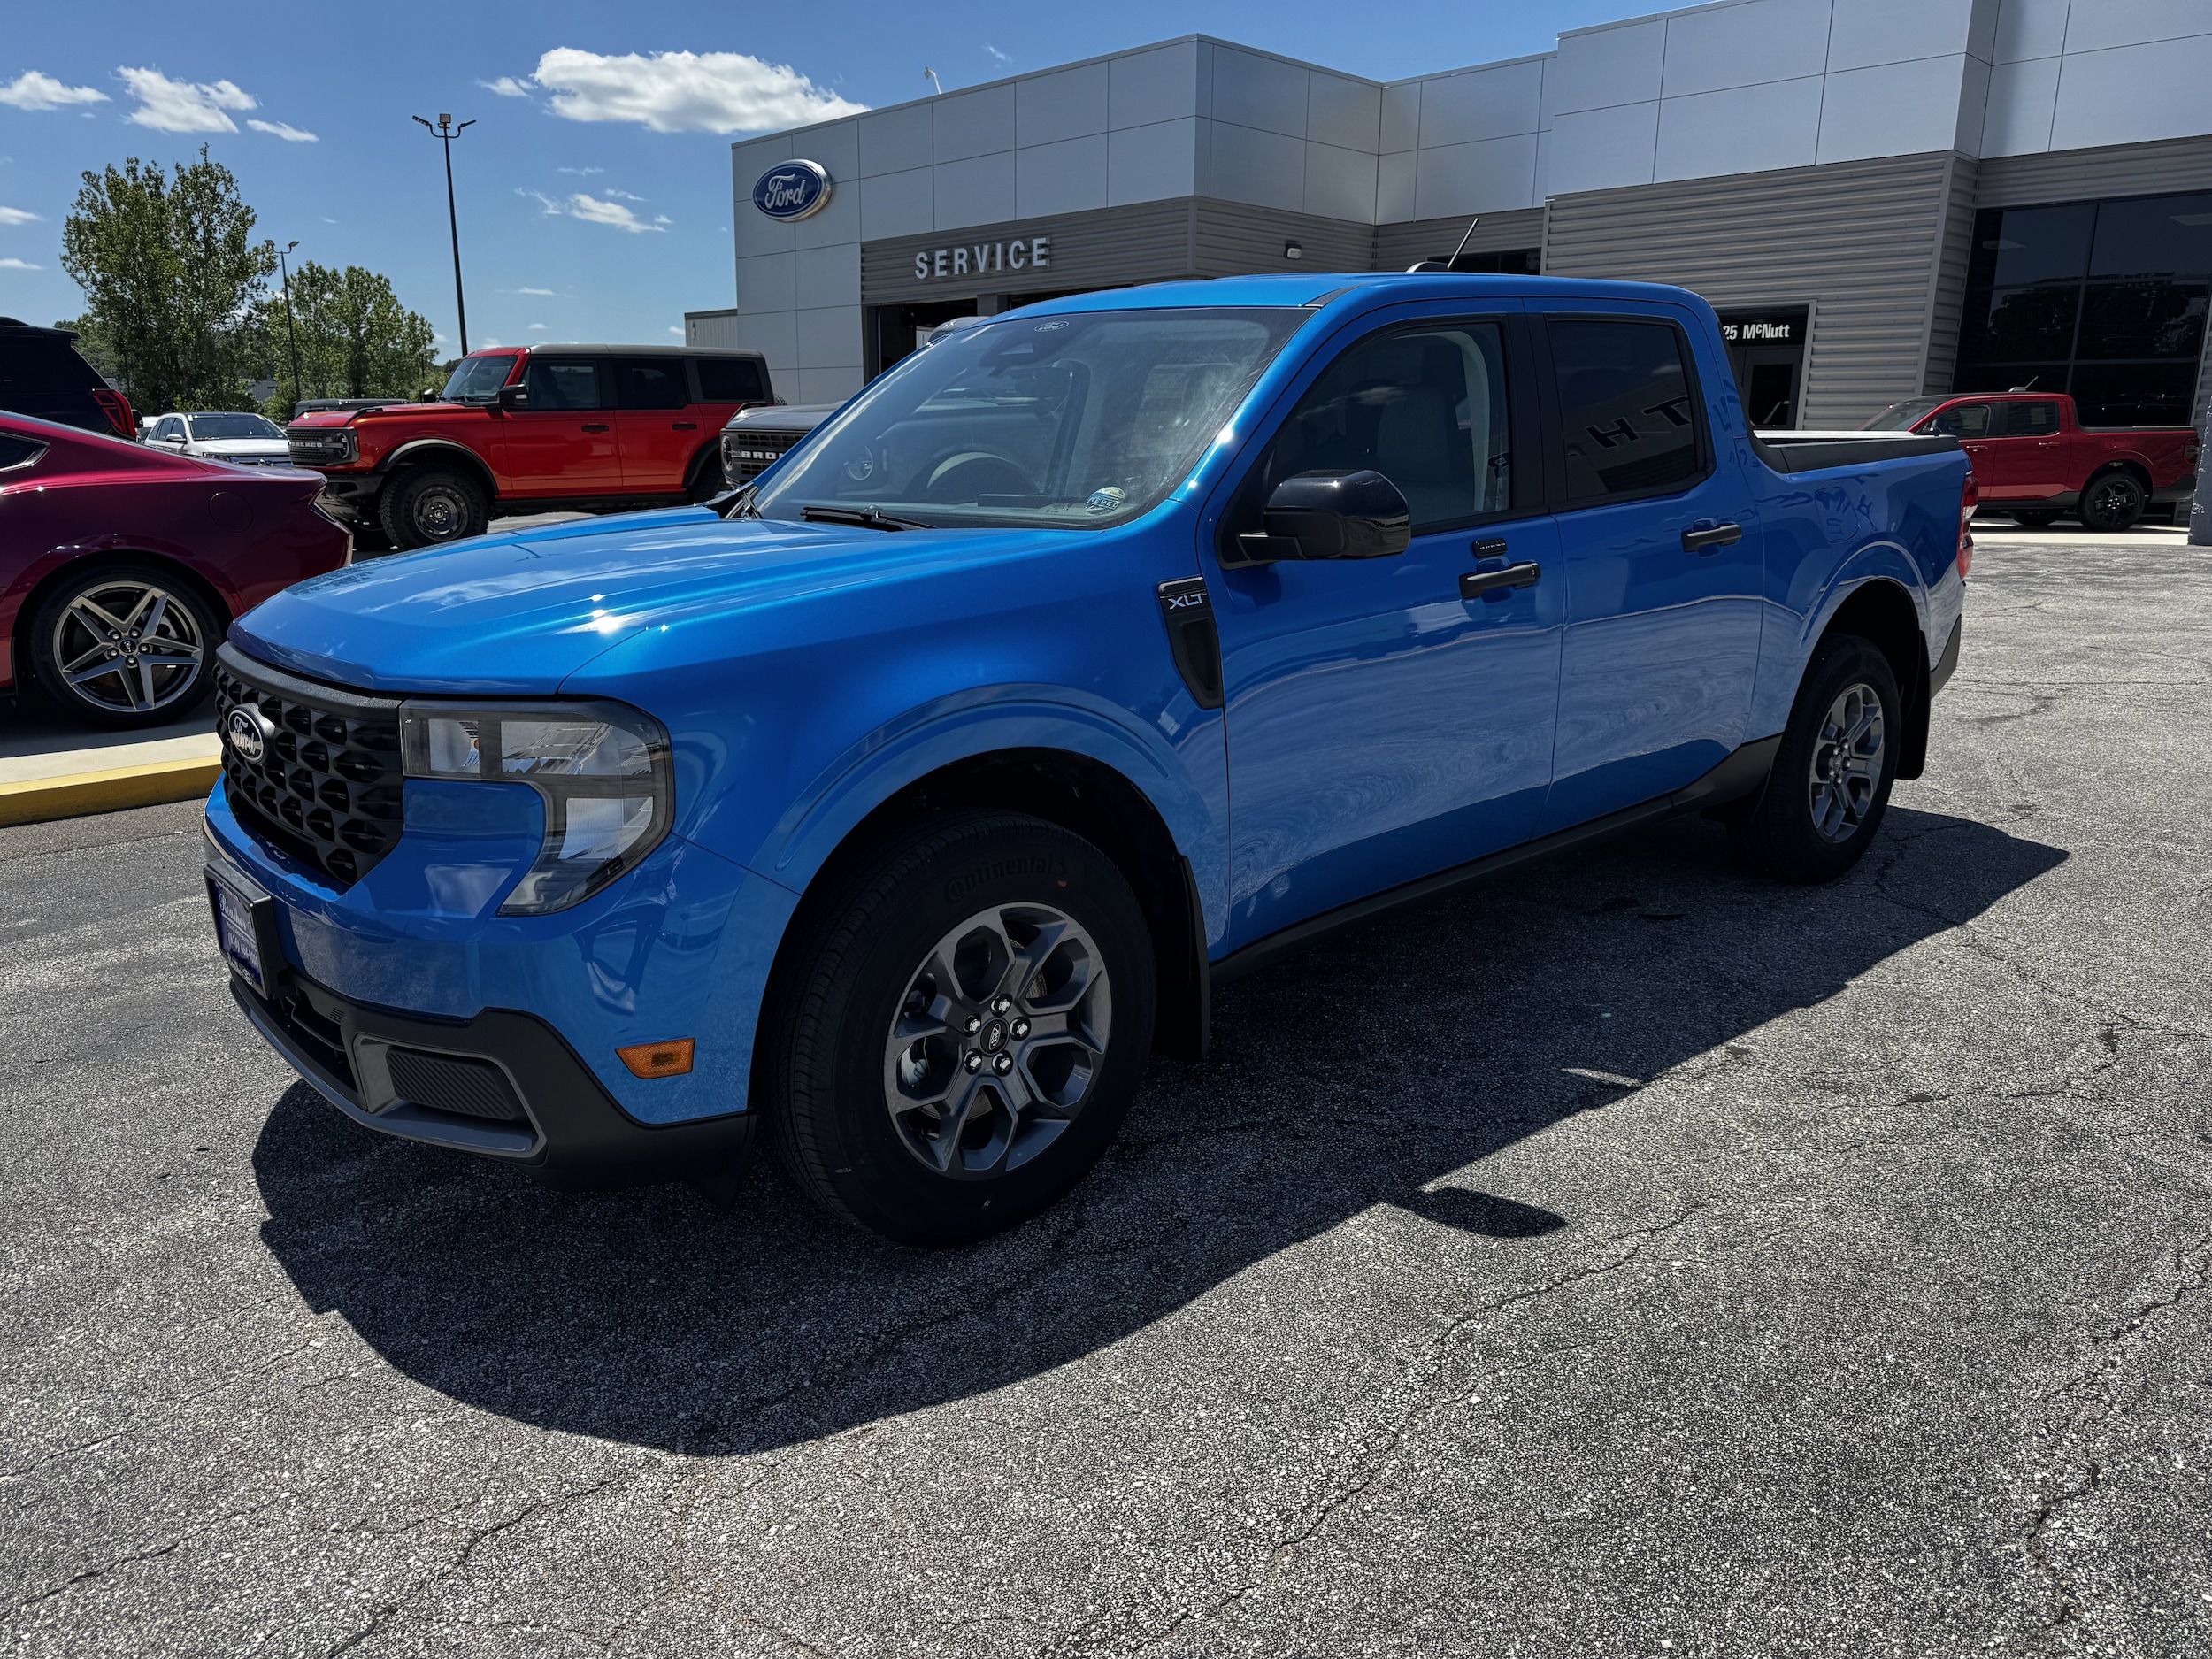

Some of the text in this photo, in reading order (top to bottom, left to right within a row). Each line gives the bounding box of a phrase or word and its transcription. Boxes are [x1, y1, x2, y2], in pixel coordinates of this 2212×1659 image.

[764, 173, 806, 209] Ford
[915, 237, 1048, 280] SERVICE
[1742, 323, 1790, 339] McNutt
[1168, 593, 1203, 610] XLT
[234, 715, 256, 755] Ford
[944, 855, 1053, 904] Continental
